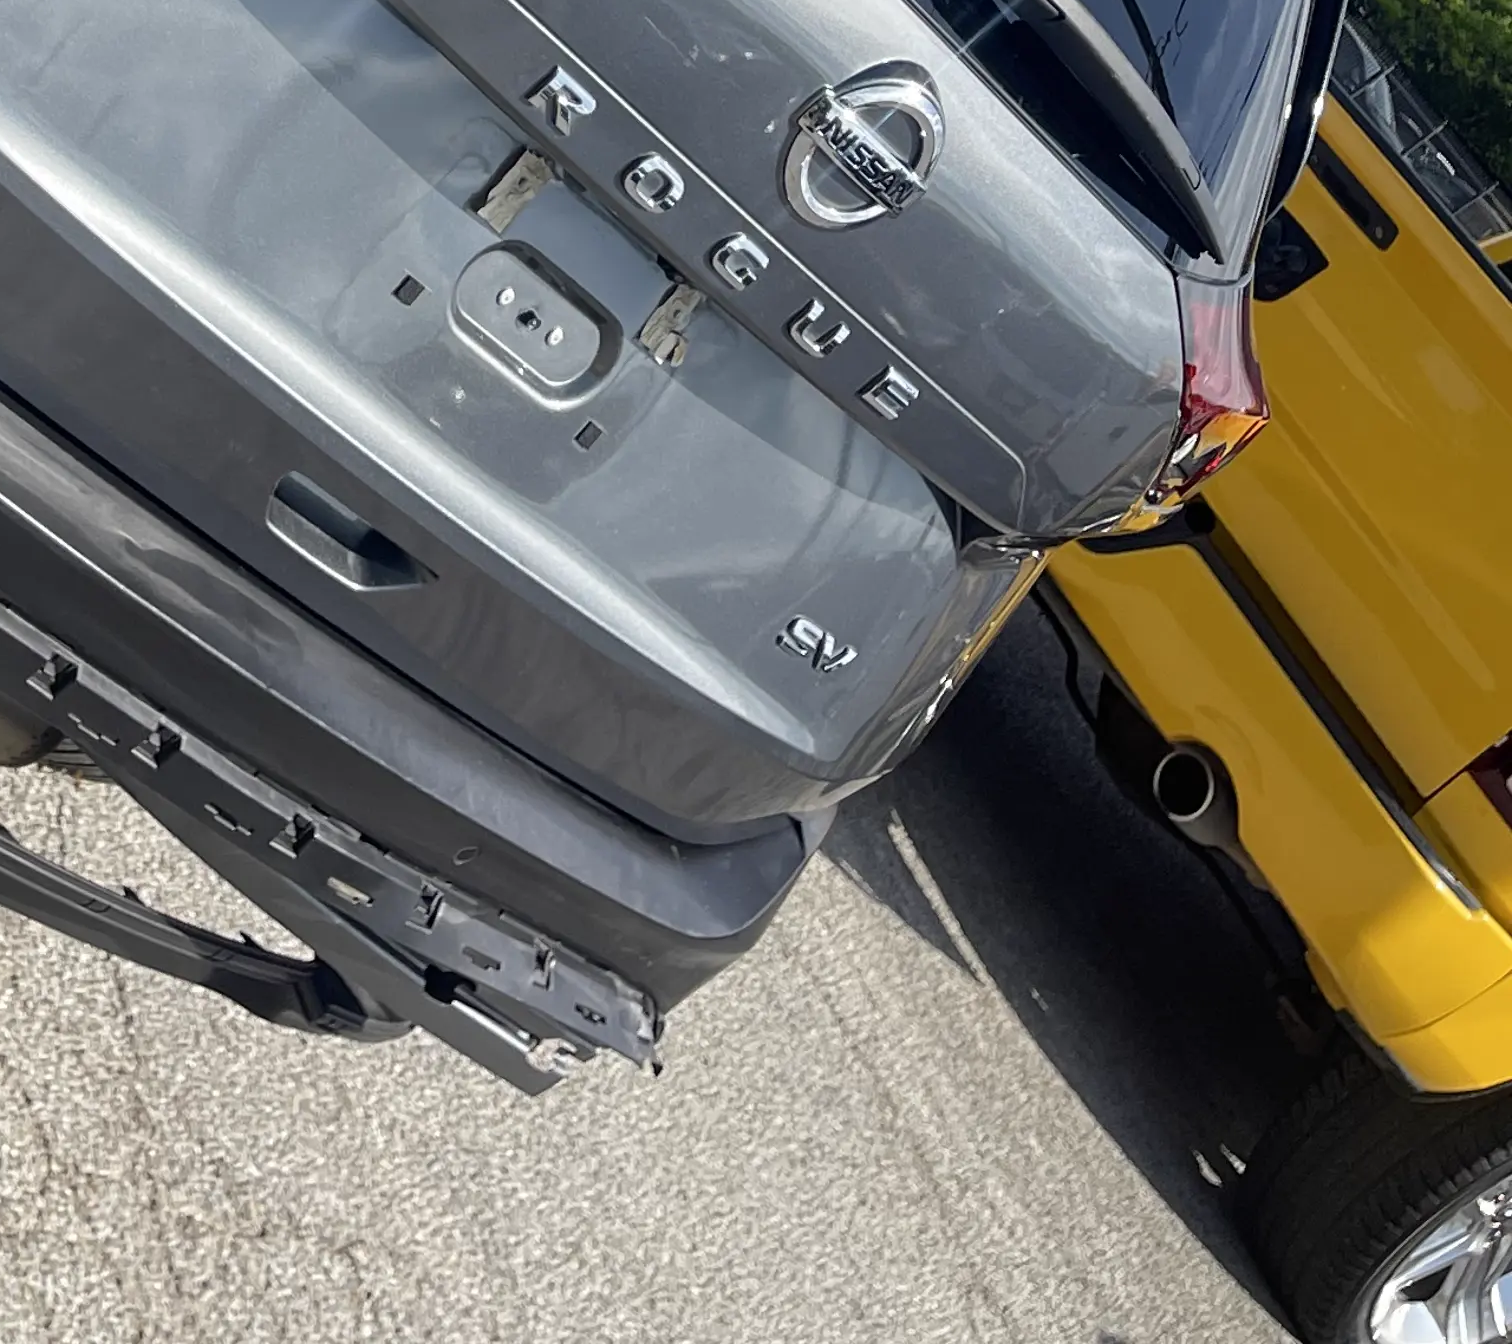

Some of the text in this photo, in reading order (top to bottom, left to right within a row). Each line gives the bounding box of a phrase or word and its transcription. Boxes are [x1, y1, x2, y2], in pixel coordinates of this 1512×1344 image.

[820, 116, 915, 205] NISSAN
[525, 65, 919, 420] ROGUE
[775, 614, 858, 673] SV
